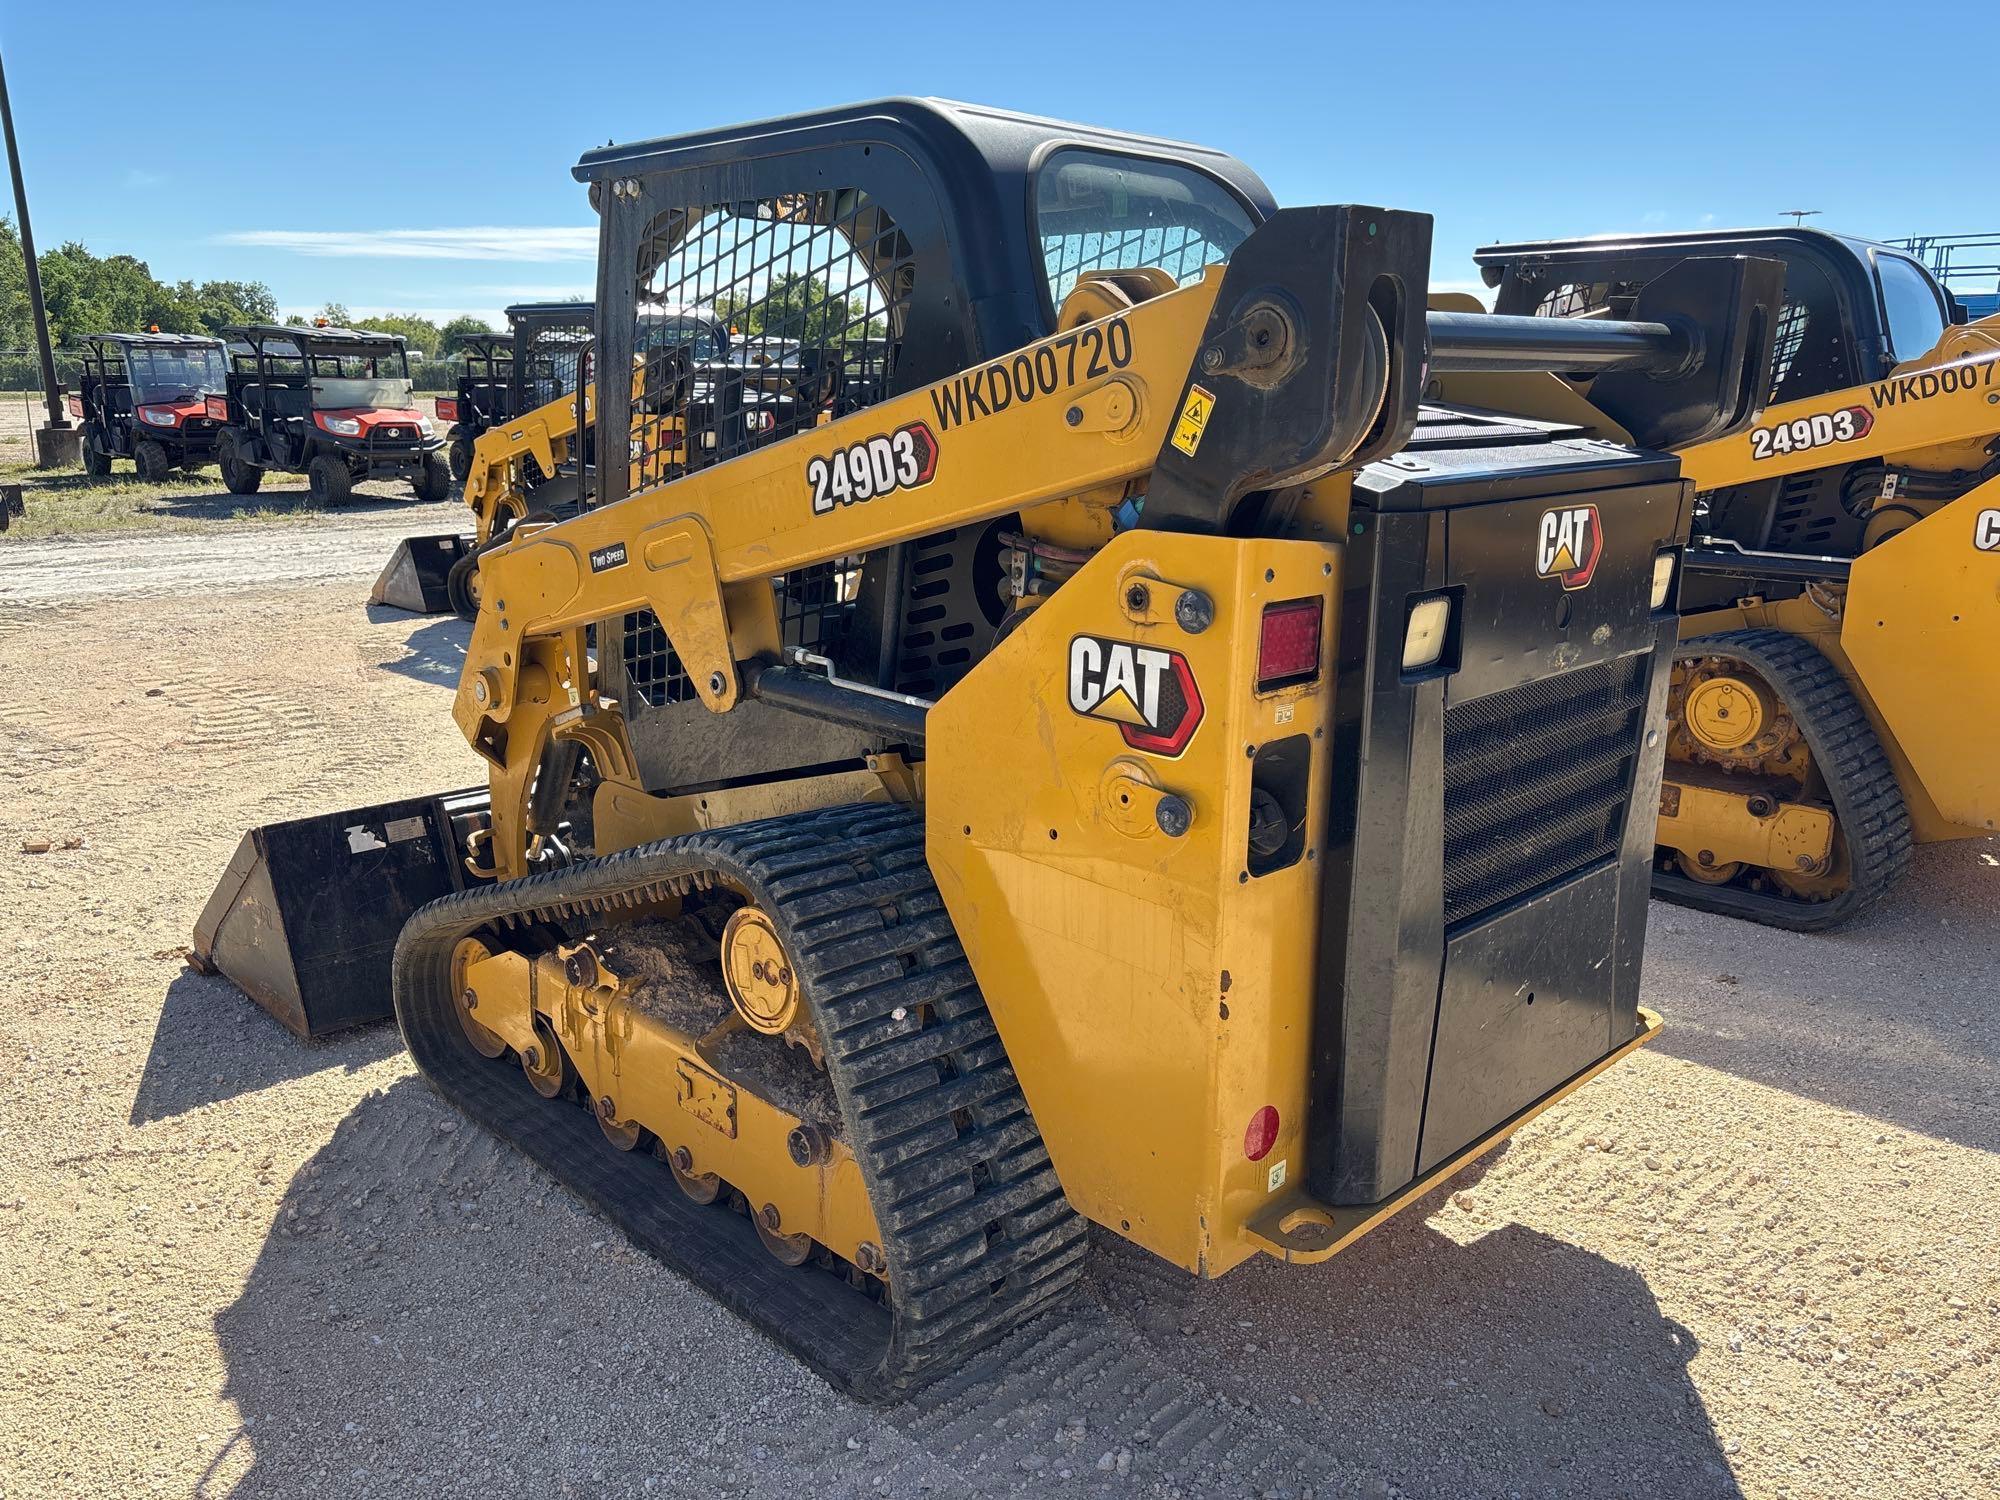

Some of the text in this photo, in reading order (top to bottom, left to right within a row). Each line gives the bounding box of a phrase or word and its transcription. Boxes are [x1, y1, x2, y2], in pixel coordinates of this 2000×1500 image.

[930, 317, 1133, 431] WKD00720
[1870, 358, 2000, 409] WKD007
[809, 430, 919, 512] 249D3
[1751, 410, 1855, 459] 249D3
[1538, 508, 1590, 574] CAT
[1070, 637, 1170, 728] CAT
